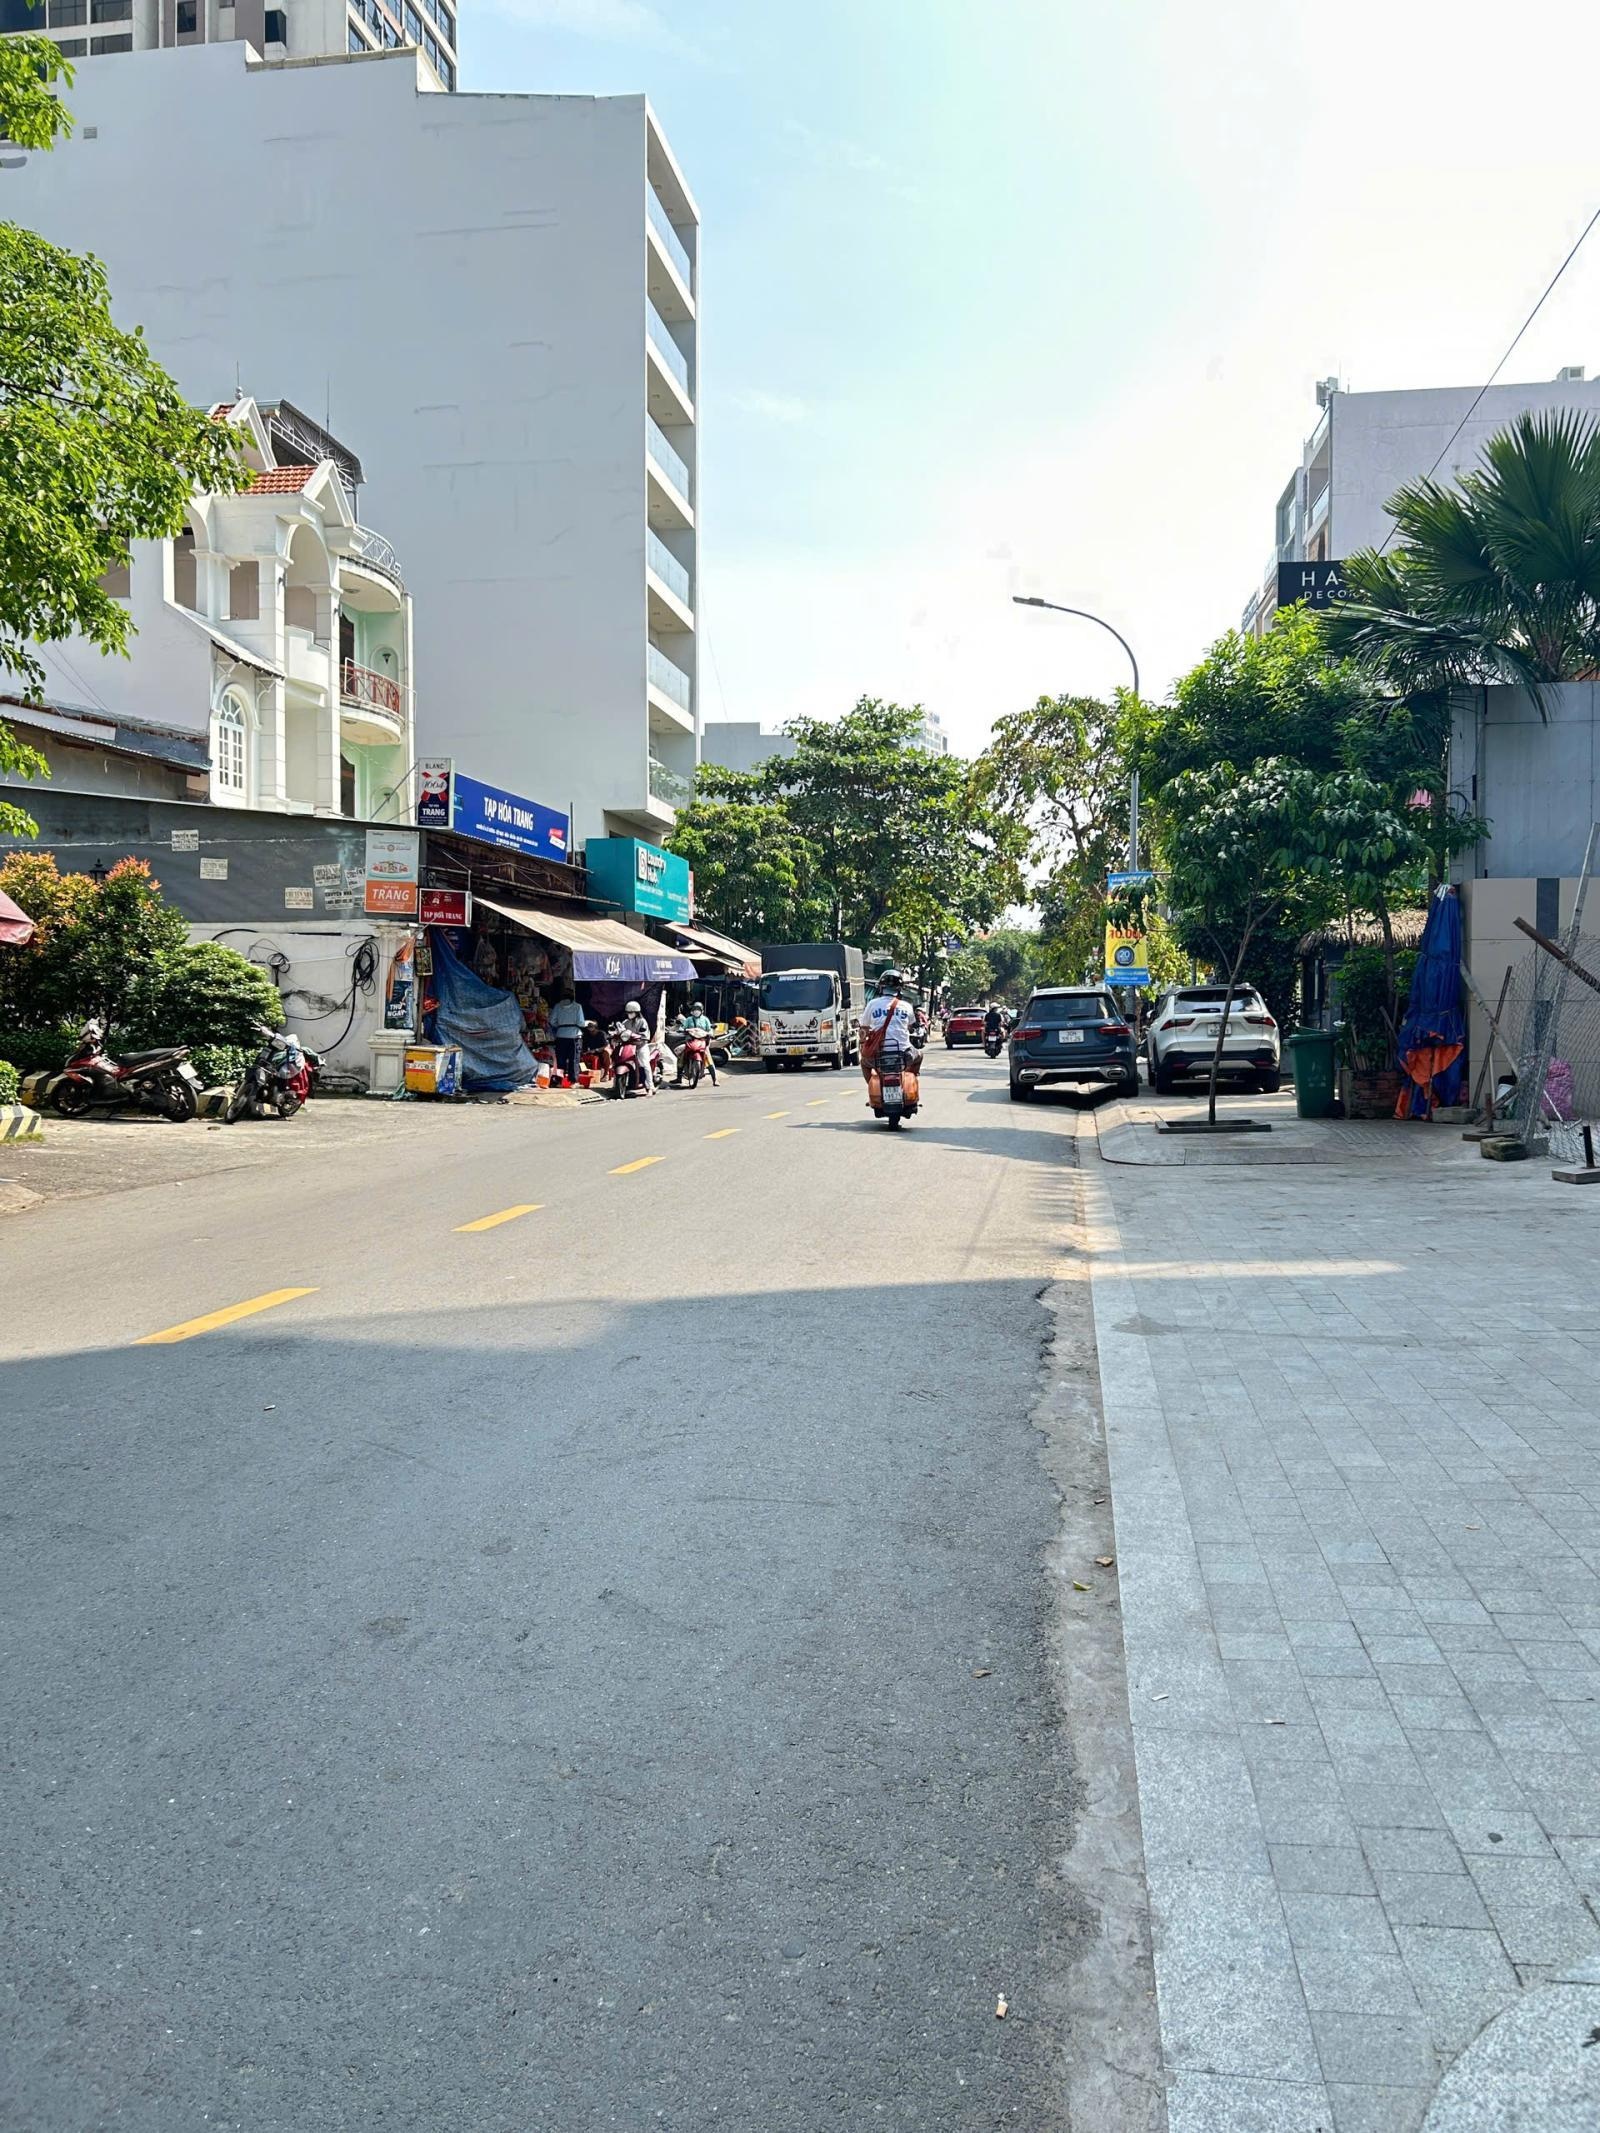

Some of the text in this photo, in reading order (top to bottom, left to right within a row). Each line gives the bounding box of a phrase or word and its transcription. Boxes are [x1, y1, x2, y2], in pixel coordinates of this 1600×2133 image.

[1301, 570, 1340, 587] HA
[422, 808, 446, 816] TRANG
[484, 797, 498, 821] TẠP
[513, 807, 534, 831] TRANG
[372, 888, 410, 901] TRANG
[445, 912, 463, 920] TRANG
[1119, 950, 1131, 958] 20
